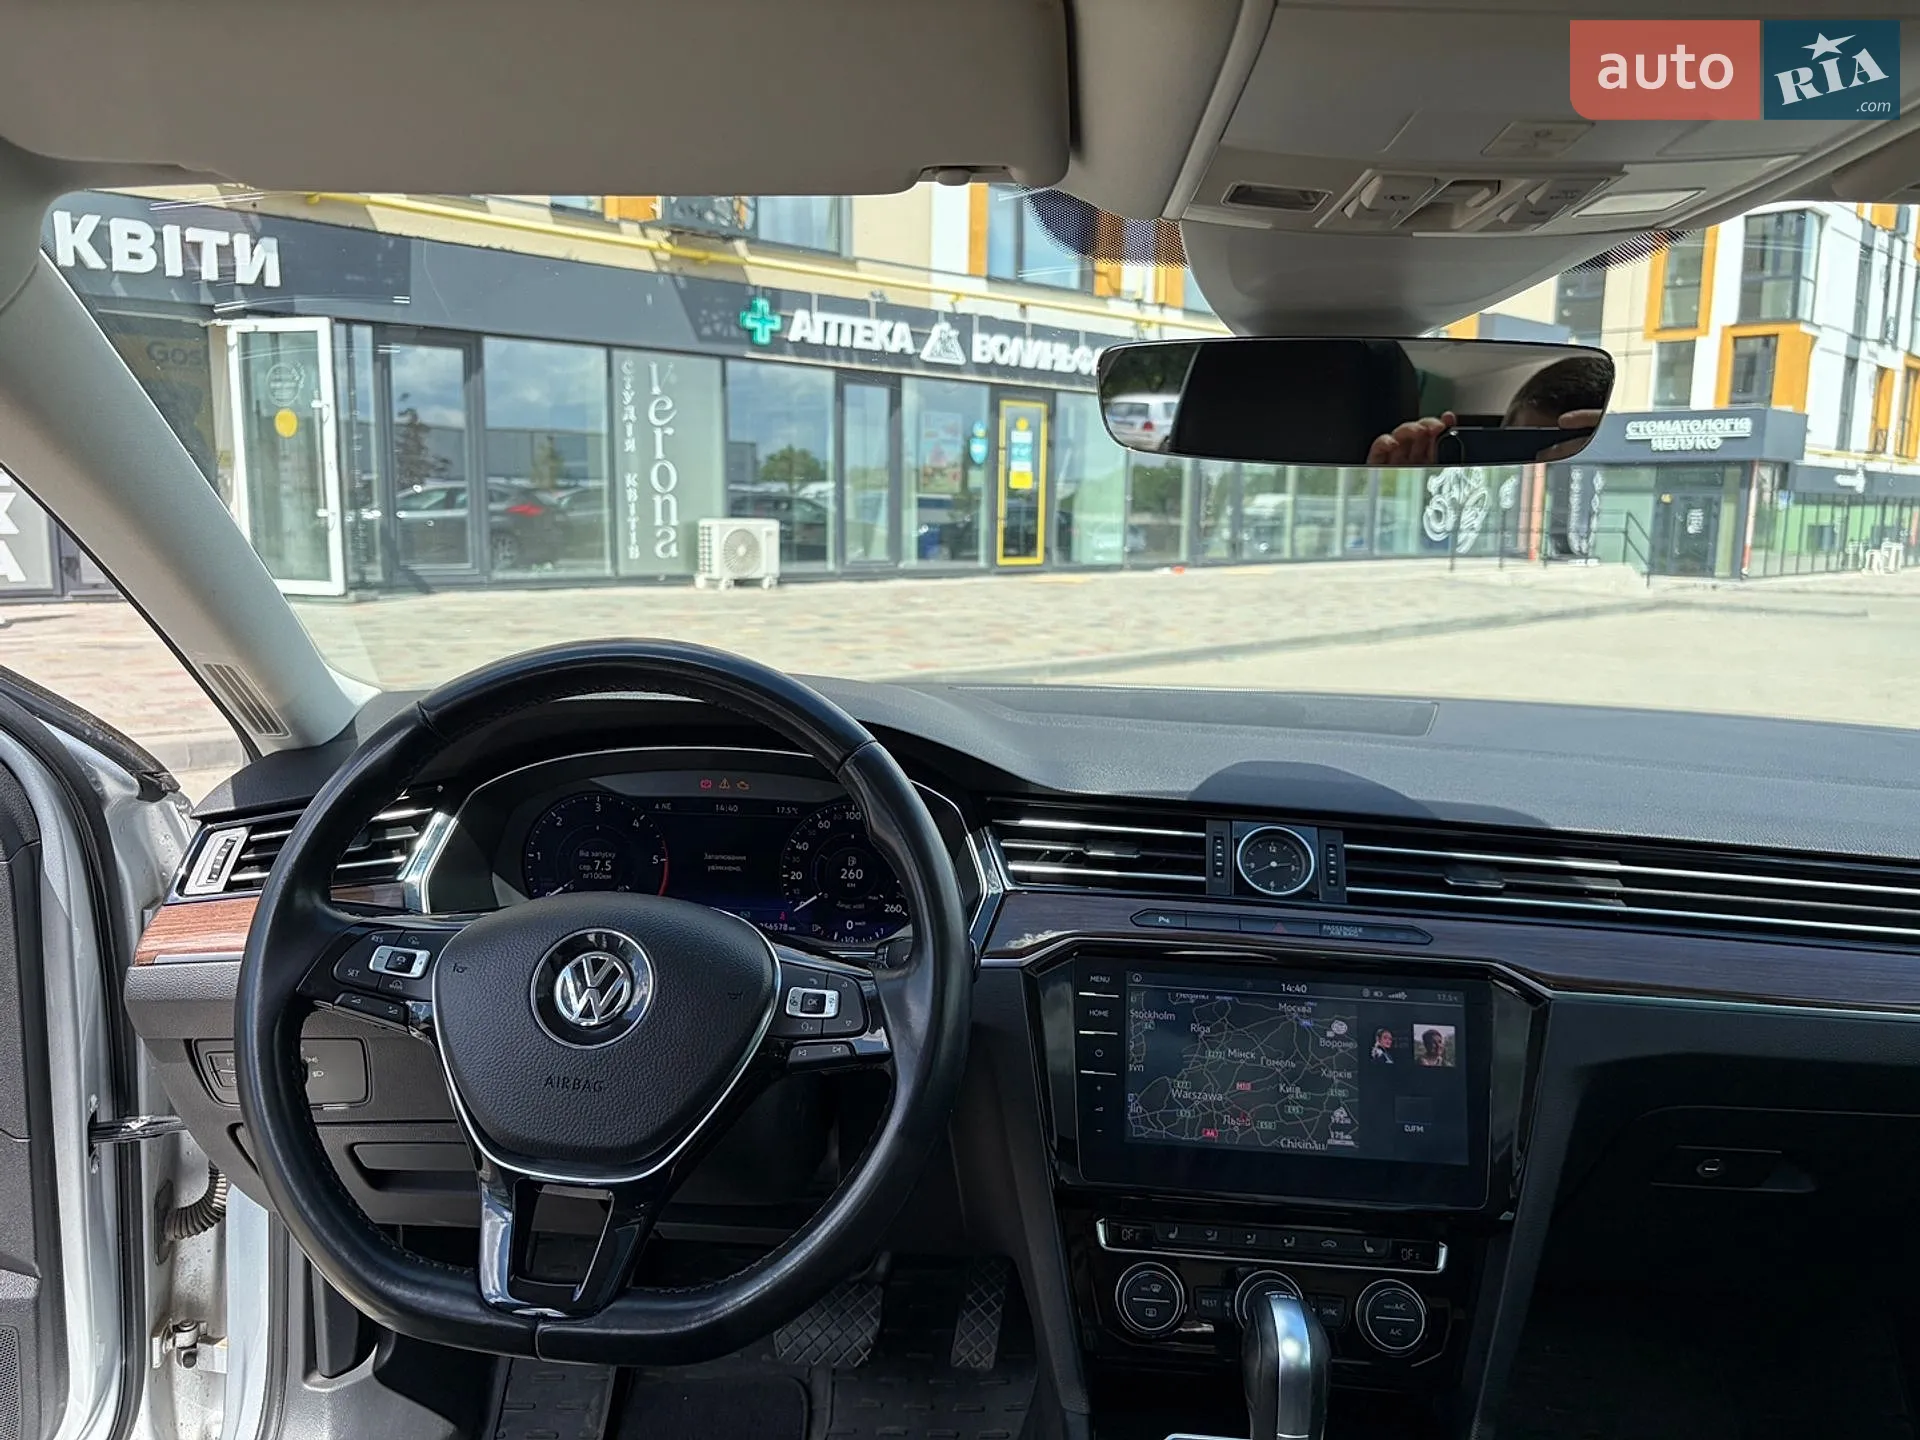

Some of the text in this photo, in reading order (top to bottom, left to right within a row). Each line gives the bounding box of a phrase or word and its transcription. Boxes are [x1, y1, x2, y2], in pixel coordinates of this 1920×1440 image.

[52, 209, 282, 288] КВІТИ
[787, 309, 917, 355] АПТЕКА
[594, 860, 612, 872] 7.5
[840, 868, 864, 880] 260
[883, 903, 903, 913] 260
[1090, 975, 1111, 984] MENU
[1280, 983, 1308, 994] 14:40
[1089, 1009, 1110, 1017] HOME
[1278, 1002, 1312, 1014] Москва
[1129, 1008, 1176, 1021] Stockholm
[1227, 1050, 1256, 1060] Мінск
[544, 1075, 605, 1093] AIRBAG
[1171, 1088, 1223, 1102] Warszawa
